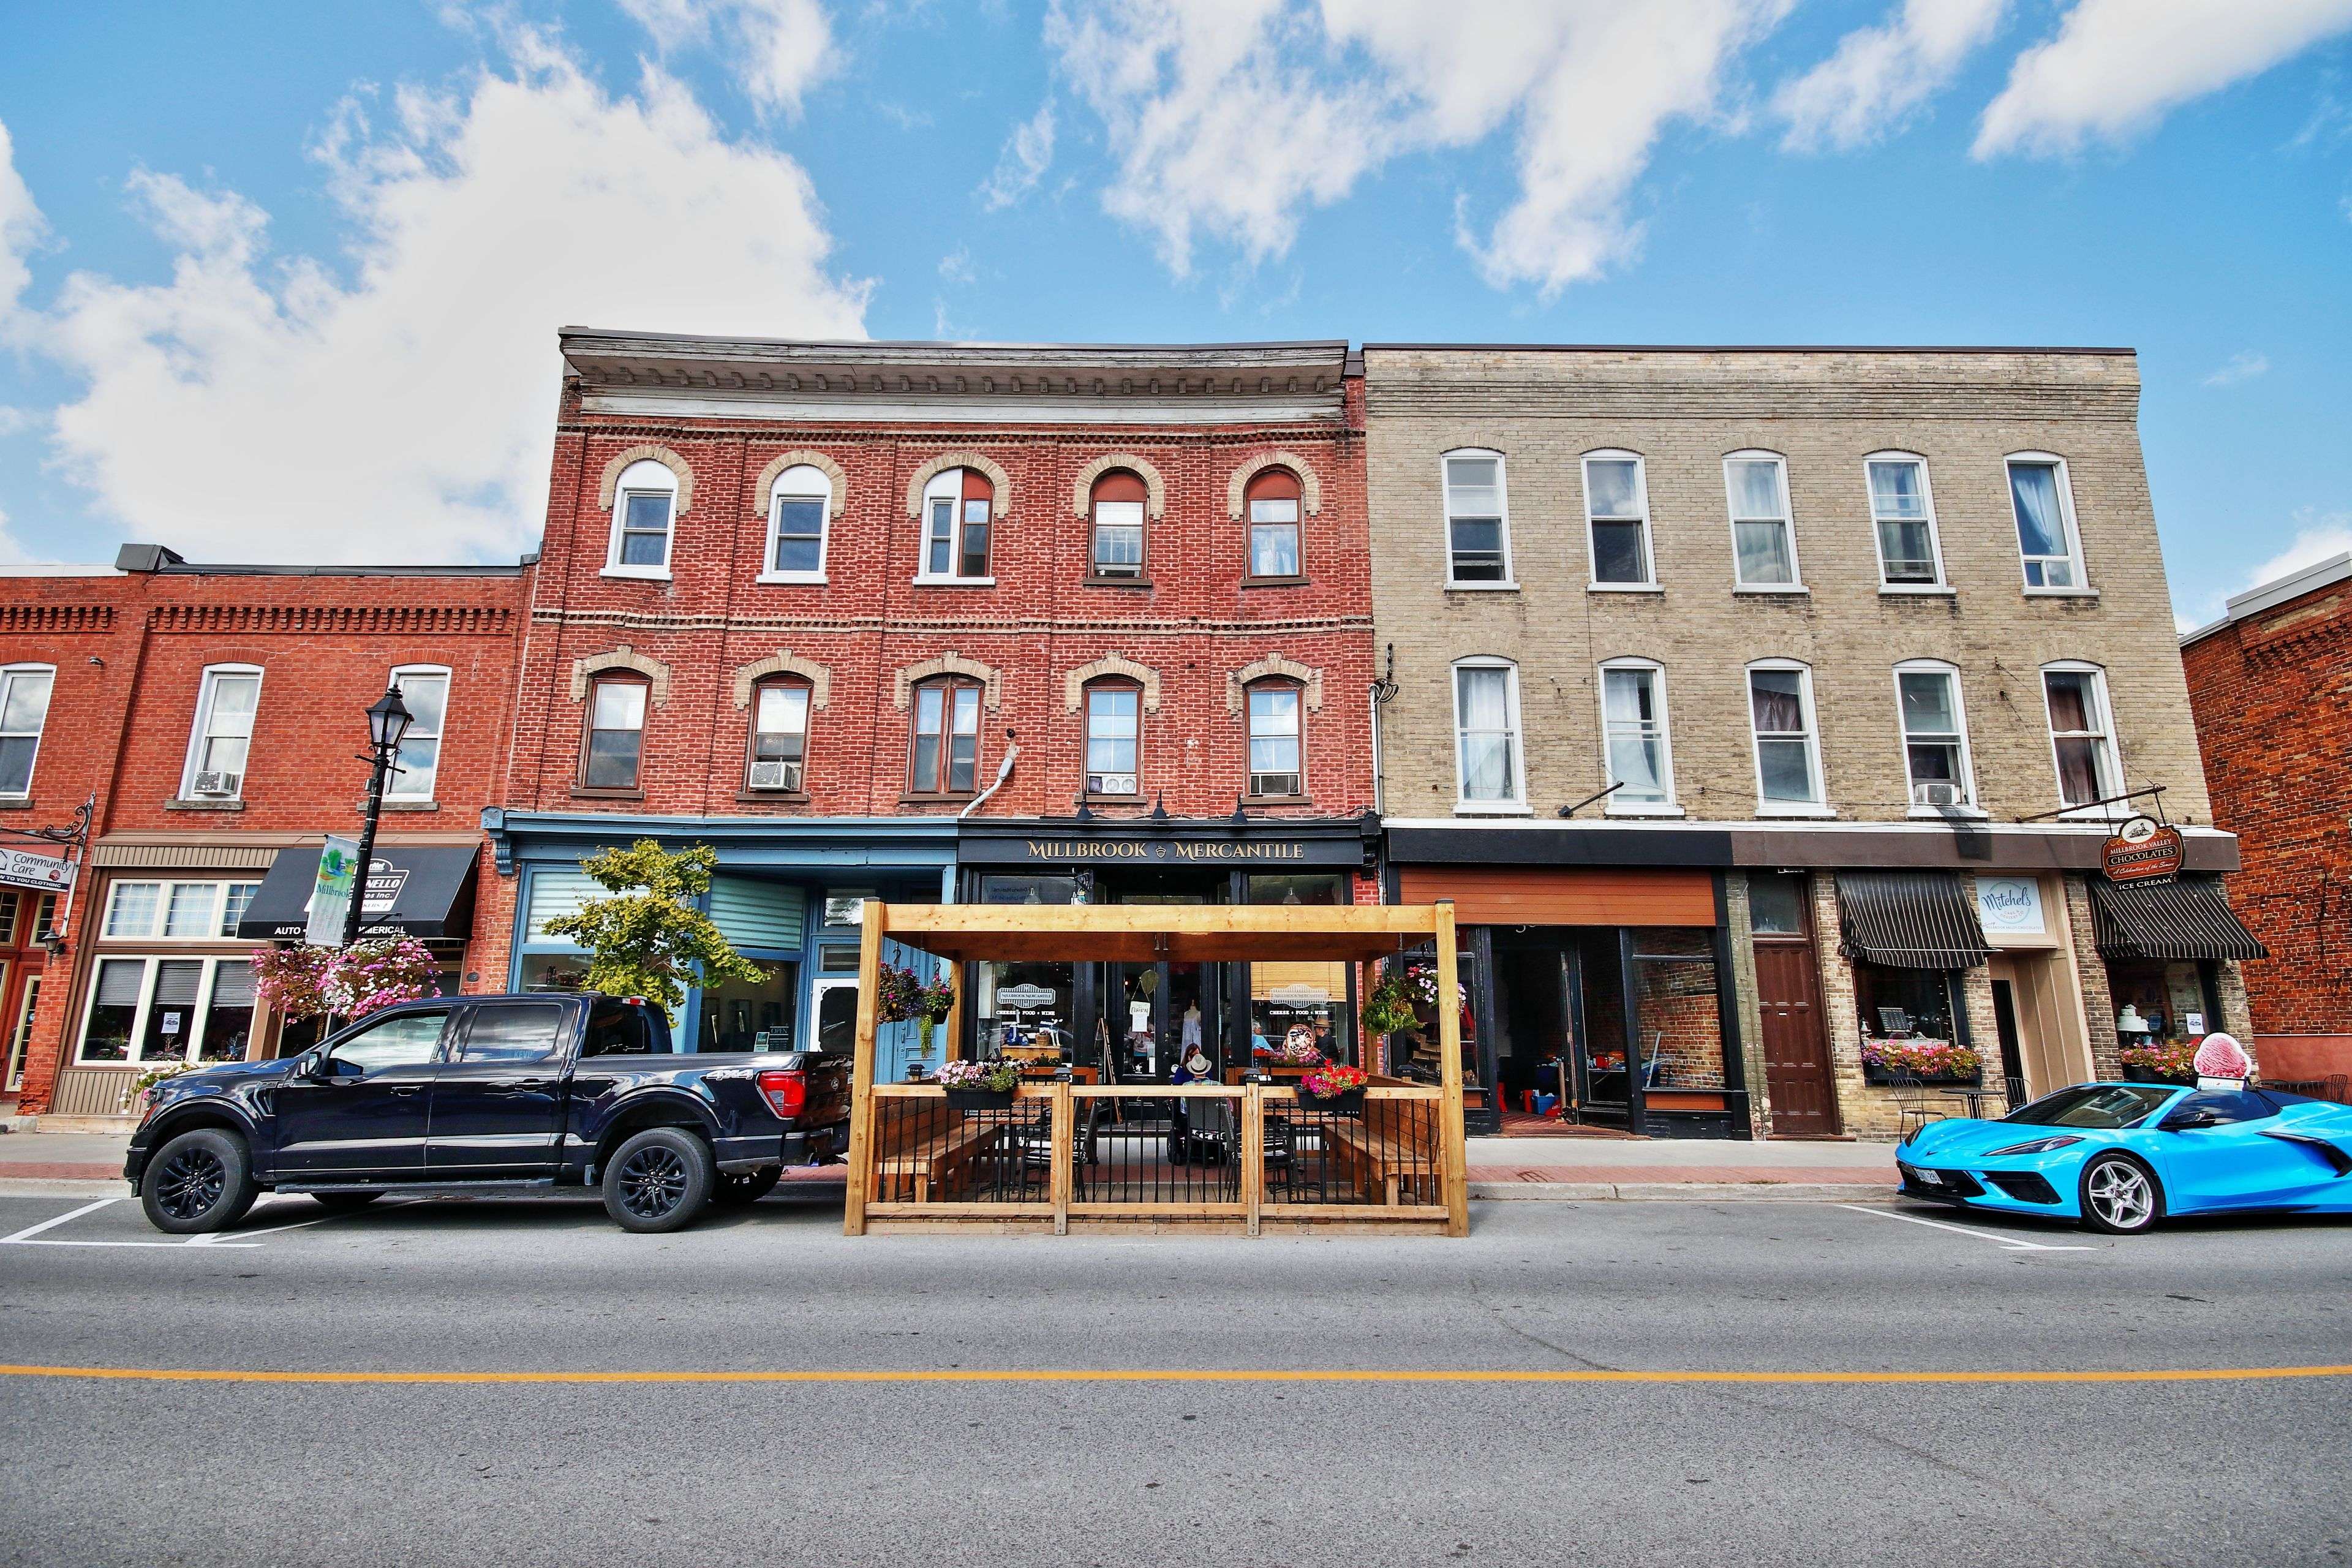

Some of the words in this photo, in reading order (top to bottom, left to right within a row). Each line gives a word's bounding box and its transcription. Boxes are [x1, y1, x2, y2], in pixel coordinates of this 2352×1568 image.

[1027, 841, 1148, 860] MILLBROOK
[1173, 842, 1305, 861] MERCANTILE
[2110, 843, 2148, 855] MILLBROOK
[2149, 838, 2172, 848] VALLEY
[14, 853, 71, 873] Community
[2111, 847, 2173, 865] CHOCOLATES
[12, 864, 36, 875] Care
[31, 880, 62, 888] CLOTHING
[366, 879, 401, 888] NELLO
[2136, 877, 2172, 888] CREAM
[316, 884, 350, 898] Millbrook
[1981, 886, 2032, 911] Mitchel's
